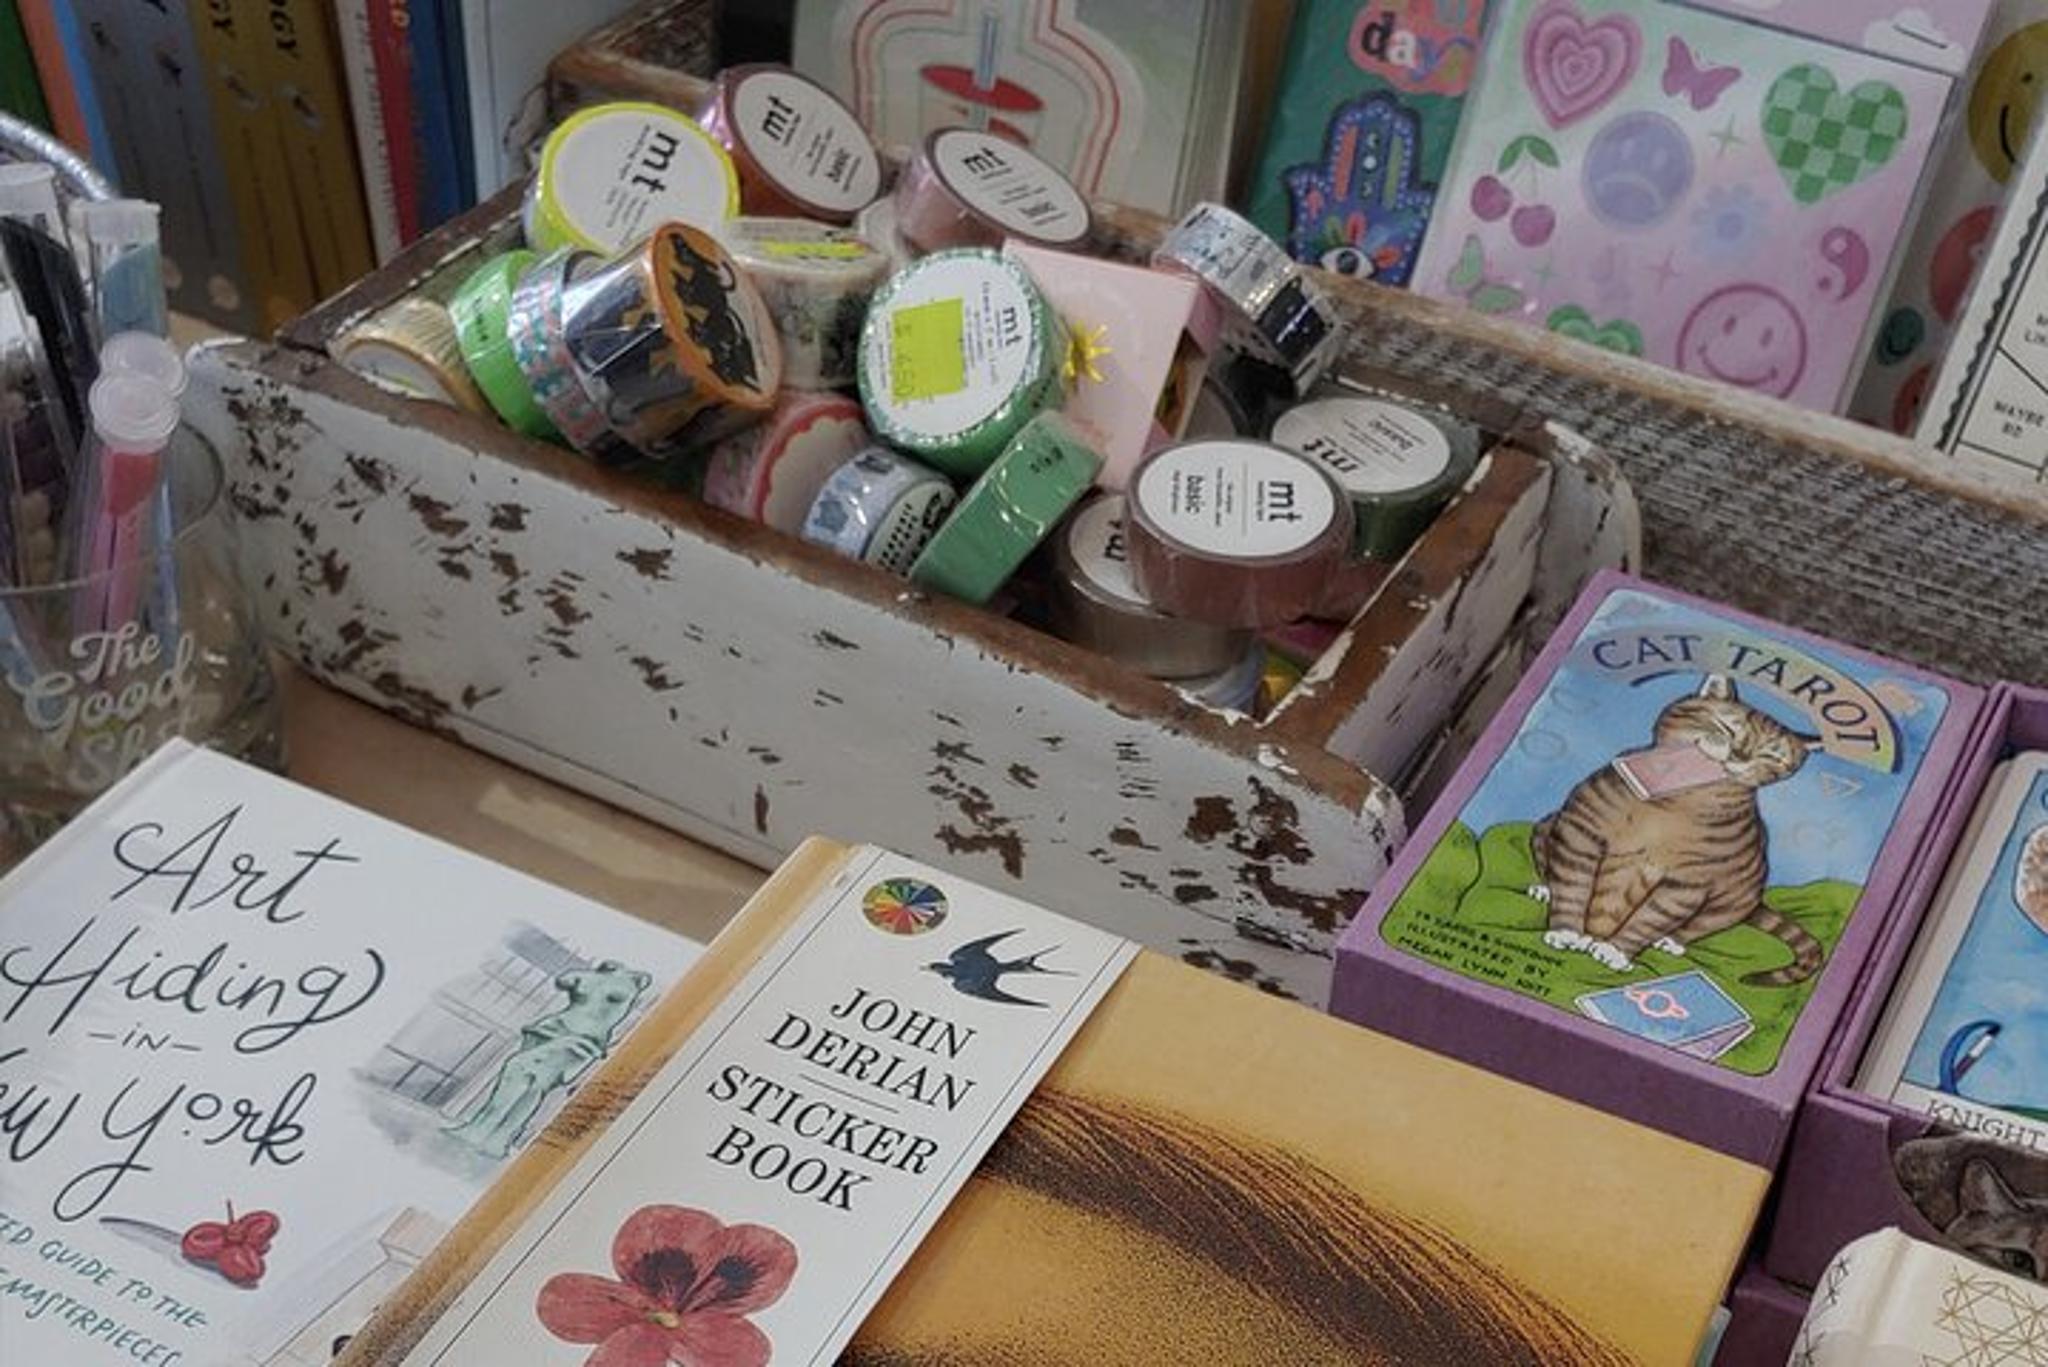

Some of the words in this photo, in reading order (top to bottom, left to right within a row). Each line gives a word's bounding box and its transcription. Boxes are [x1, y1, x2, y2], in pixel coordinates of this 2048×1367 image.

[761, 97, 796, 141] mt
[631, 131, 680, 195] mt
[965, 147, 1002, 175] mt
[1003, 306, 1020, 346] mt
[1186, 475, 1203, 518] basic
[1300, 440, 1360, 476] mt
[1268, 479, 1303, 523] mt
[70, 622, 161, 684] The
[6, 633, 195, 752] Good
[1592, 634, 1702, 670] CAT
[1726, 640, 1880, 751] TAROT
[110, 804, 360, 922] Art
[2, 916, 385, 1054] Hiding
[831, 987, 977, 1058] JOHN
[766, 1014, 976, 1112] DERIAN
[53, 1073, 317, 1222] York
[706, 1064, 939, 1174] STICKER
[707, 1126, 872, 1211] BOOK
[39, 1240, 116, 1285] GUIDE
[116, 1278, 153, 1303] TO
[152, 1295, 208, 1328] THE
